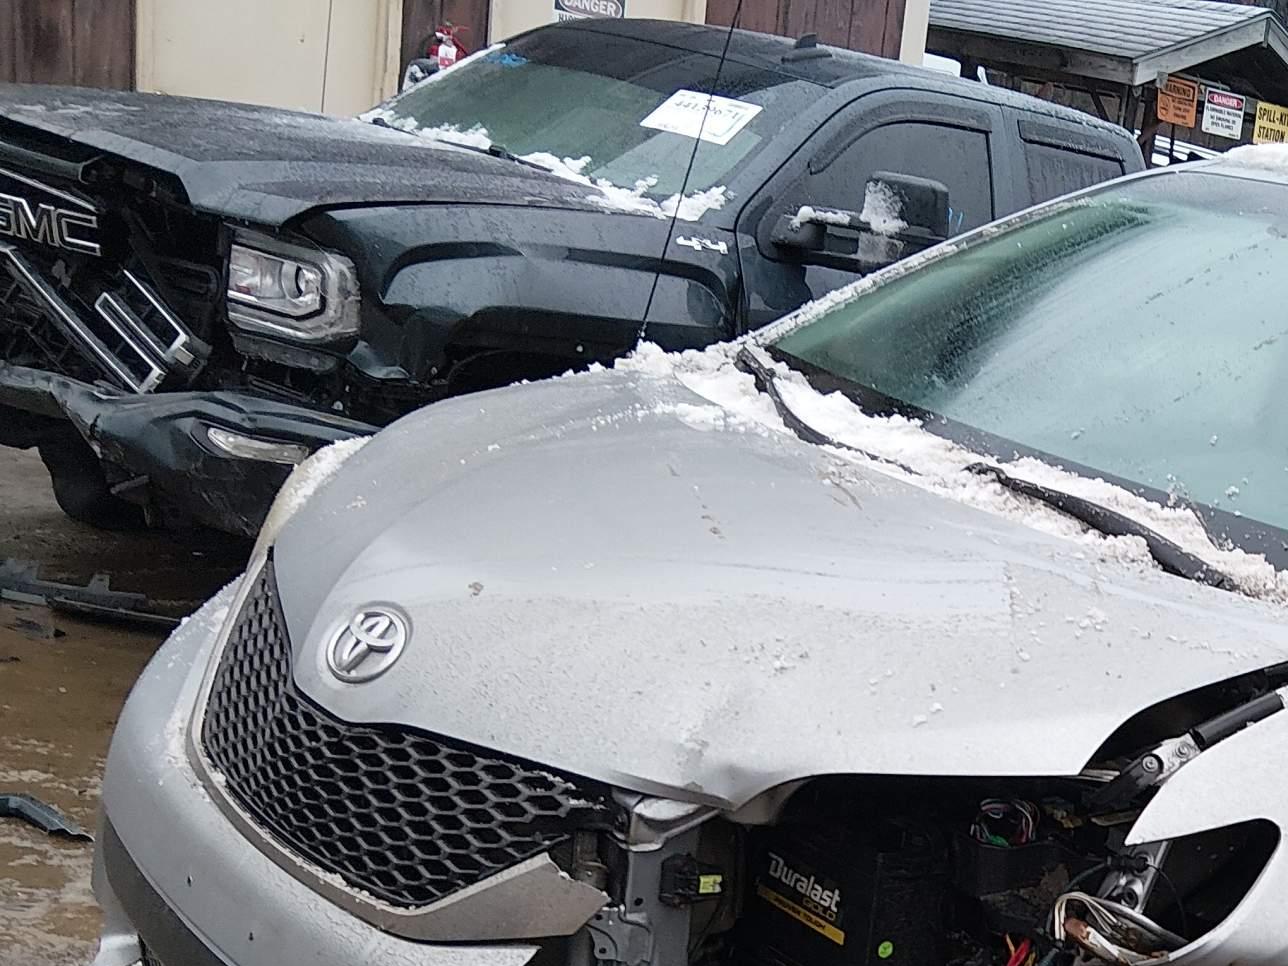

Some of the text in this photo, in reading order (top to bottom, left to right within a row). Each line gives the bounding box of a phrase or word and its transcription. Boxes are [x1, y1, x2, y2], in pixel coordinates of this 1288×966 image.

[1213, 94, 1237, 108] DANGER
[1257, 125, 1286, 143] STATION
[767, 851, 841, 913] Duralast
[802, 896, 837, 921] GOLD
